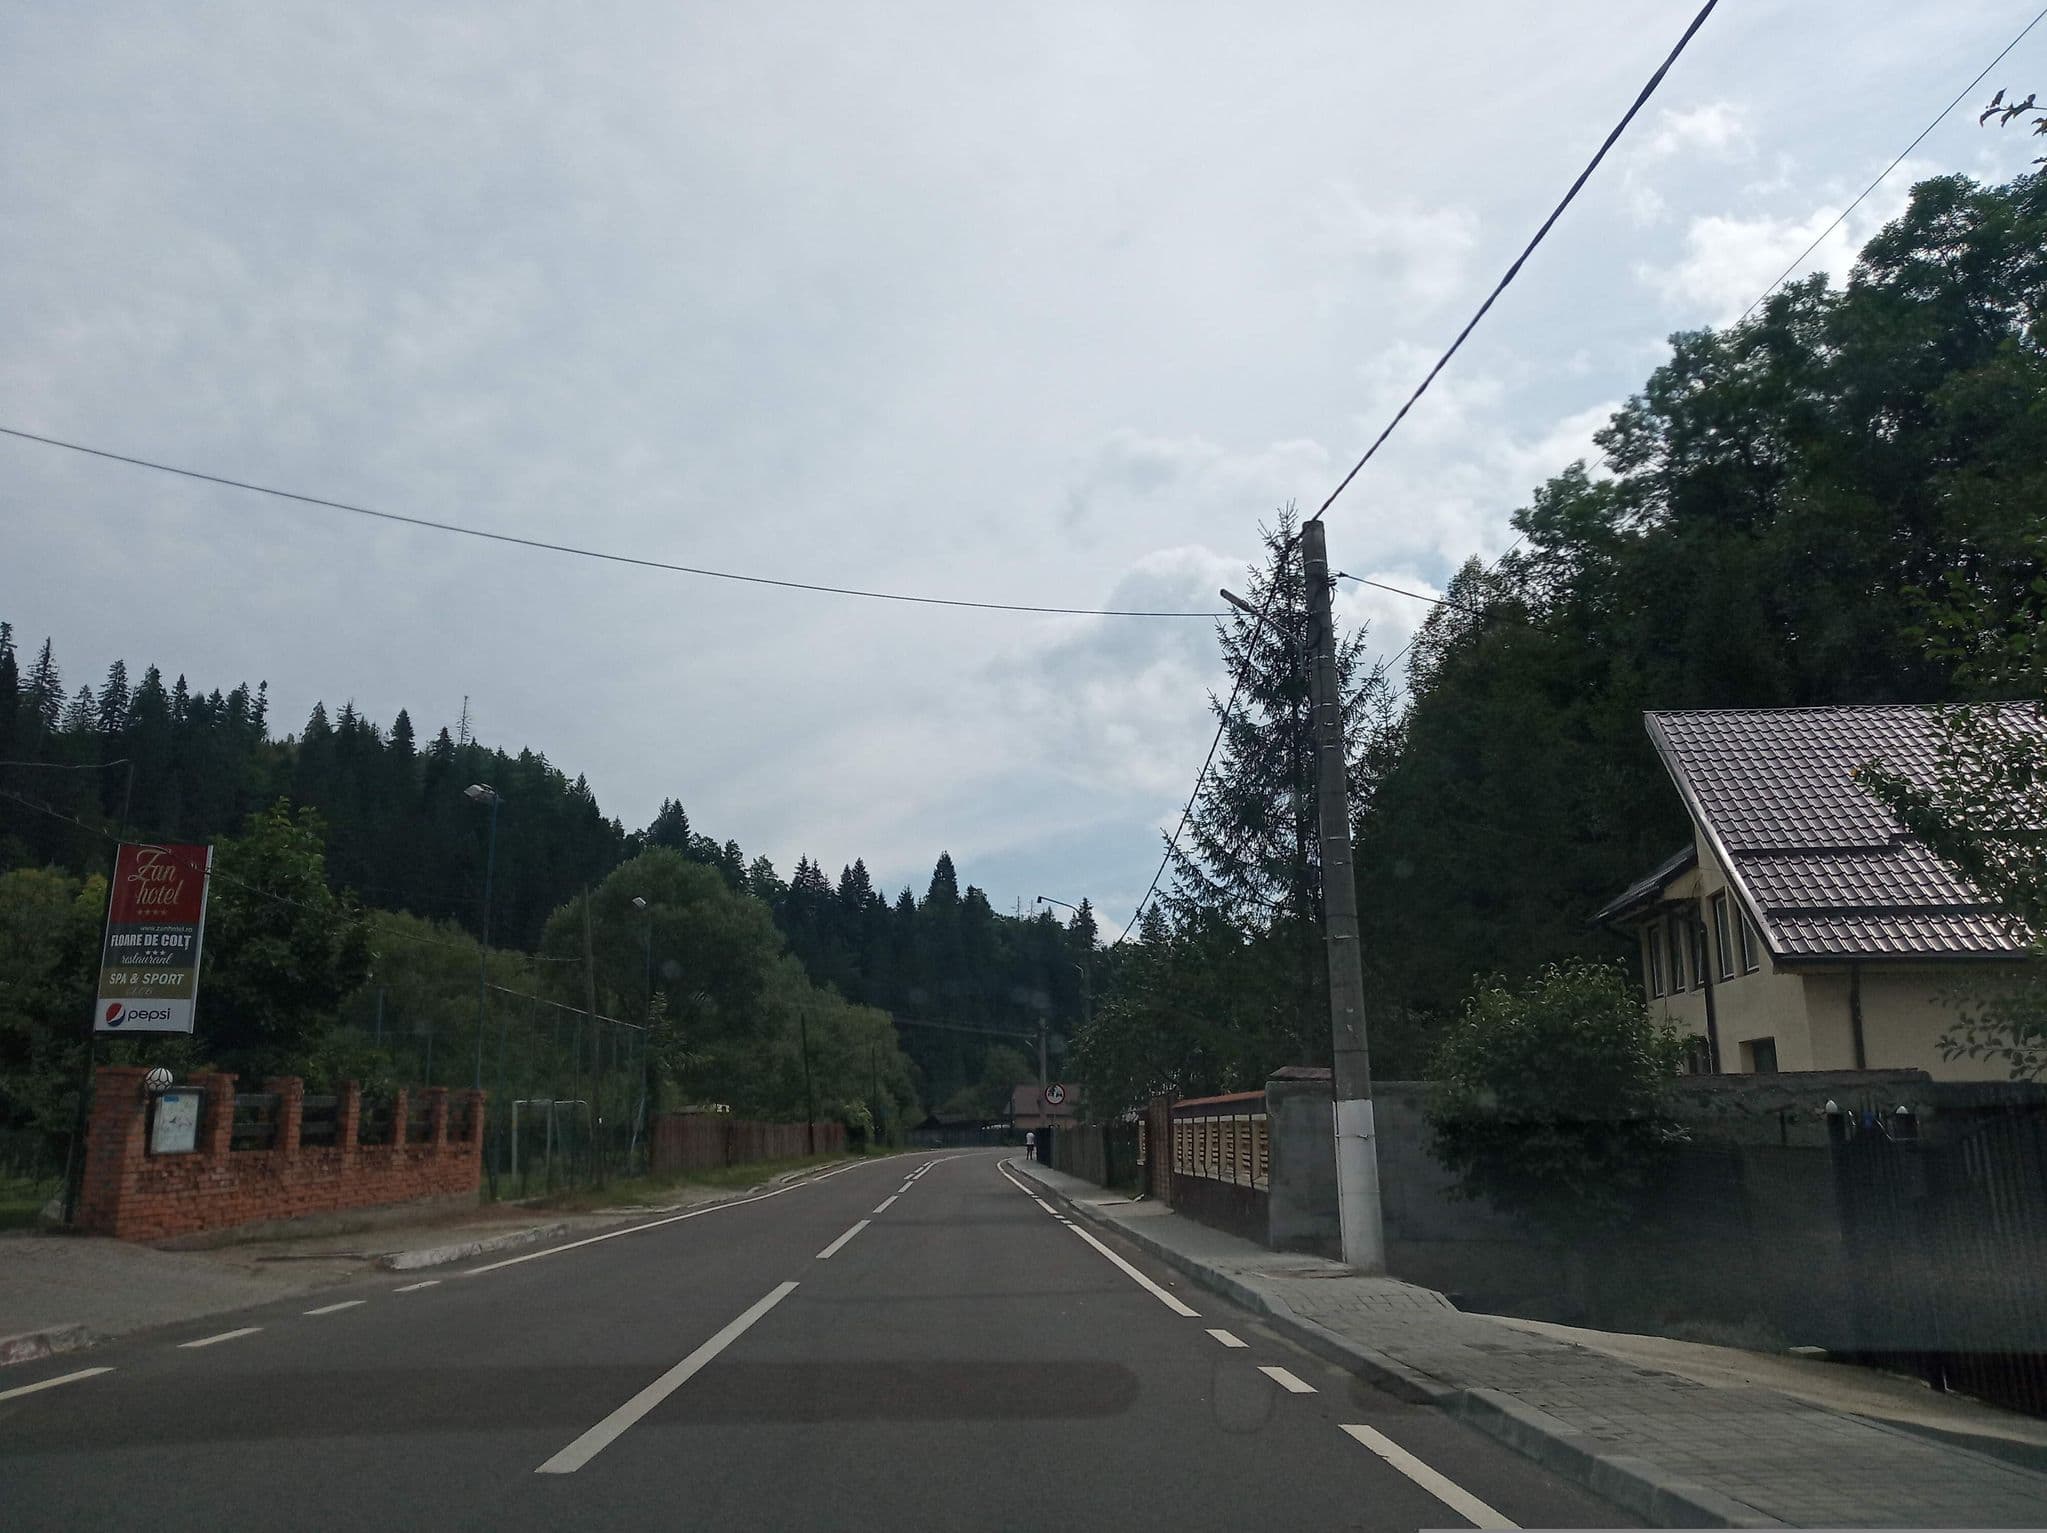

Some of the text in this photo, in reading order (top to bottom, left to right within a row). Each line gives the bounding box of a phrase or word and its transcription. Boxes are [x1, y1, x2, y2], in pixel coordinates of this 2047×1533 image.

[136, 880, 184, 905] hotel
[110, 934, 143, 947] FLOARE
[144, 934, 159, 946] DE
[121, 952, 174, 965] restaurant
[109, 973, 184, 985] SPA & SPORT
[127, 1008, 171, 1022] pepsi
